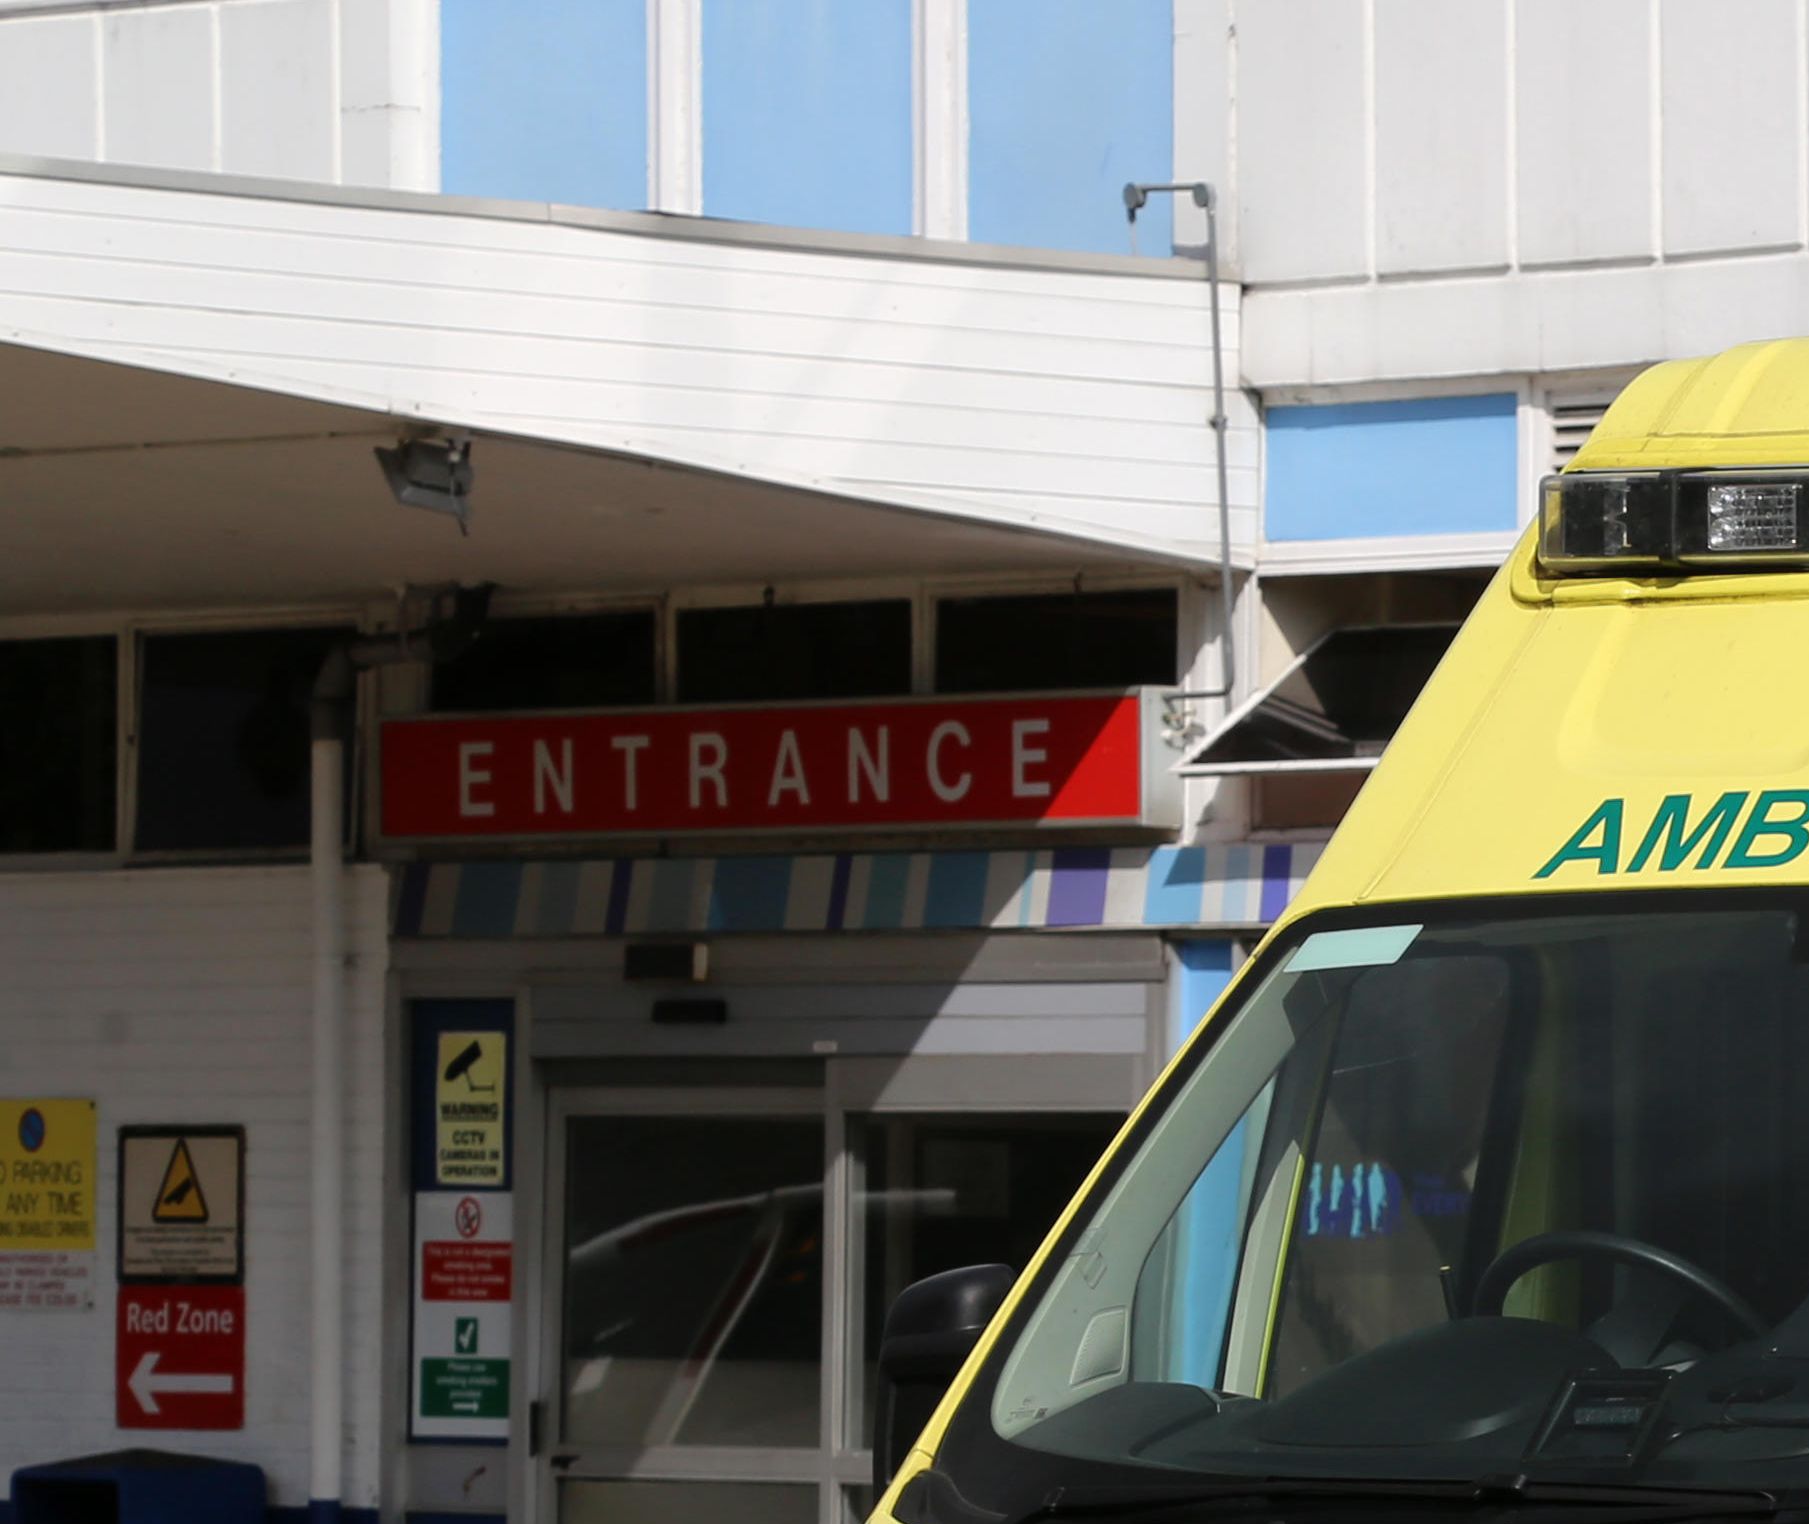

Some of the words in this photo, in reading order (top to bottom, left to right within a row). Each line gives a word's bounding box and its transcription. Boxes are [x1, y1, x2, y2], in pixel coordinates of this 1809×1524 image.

[459, 718, 1051, 818] ENTRANCE
[452, 1129, 486, 1146] CCTV
[13, 1160, 82, 1185] PARKING
[6, 1192, 40, 1215] ANY
[48, 1191, 83, 1216] TIME
[127, 1299, 169, 1334] Red
[176, 1302, 234, 1334] Zone
